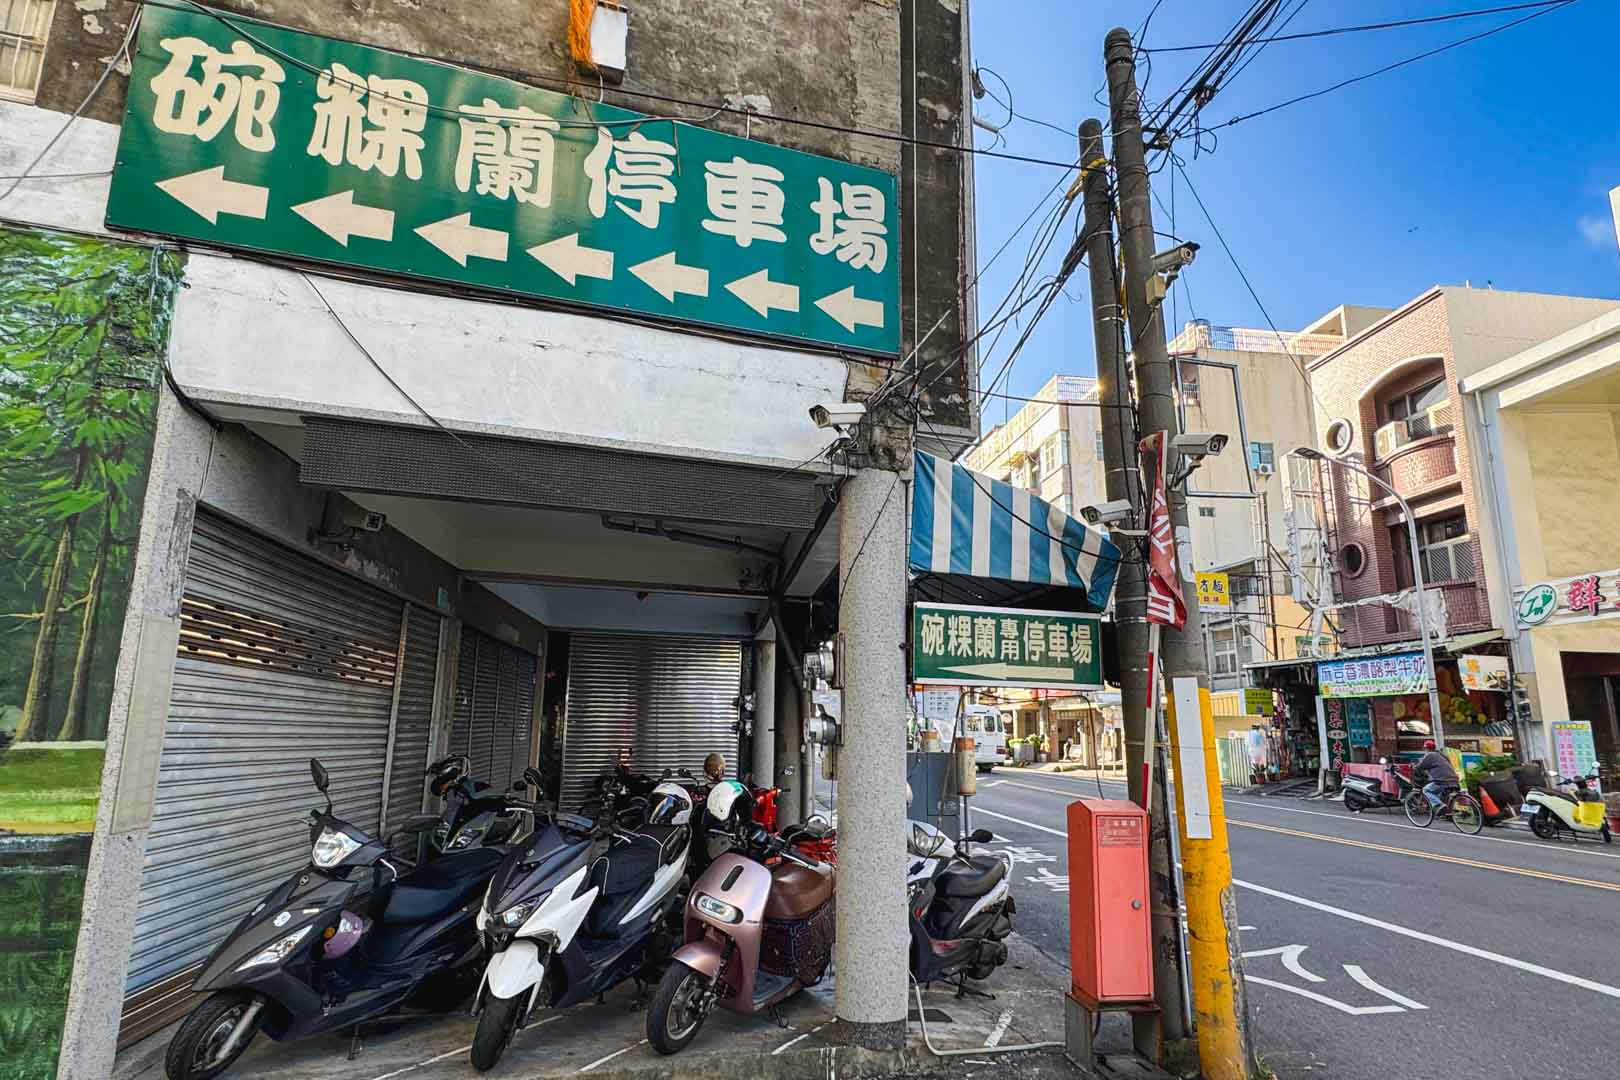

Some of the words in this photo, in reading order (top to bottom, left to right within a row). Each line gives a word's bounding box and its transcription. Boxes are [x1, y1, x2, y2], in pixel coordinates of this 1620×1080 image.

[150, 37, 888, 274] 碗粿蘭停車場
[920, 613, 1093, 664] 碗粿蘭專用停車場
